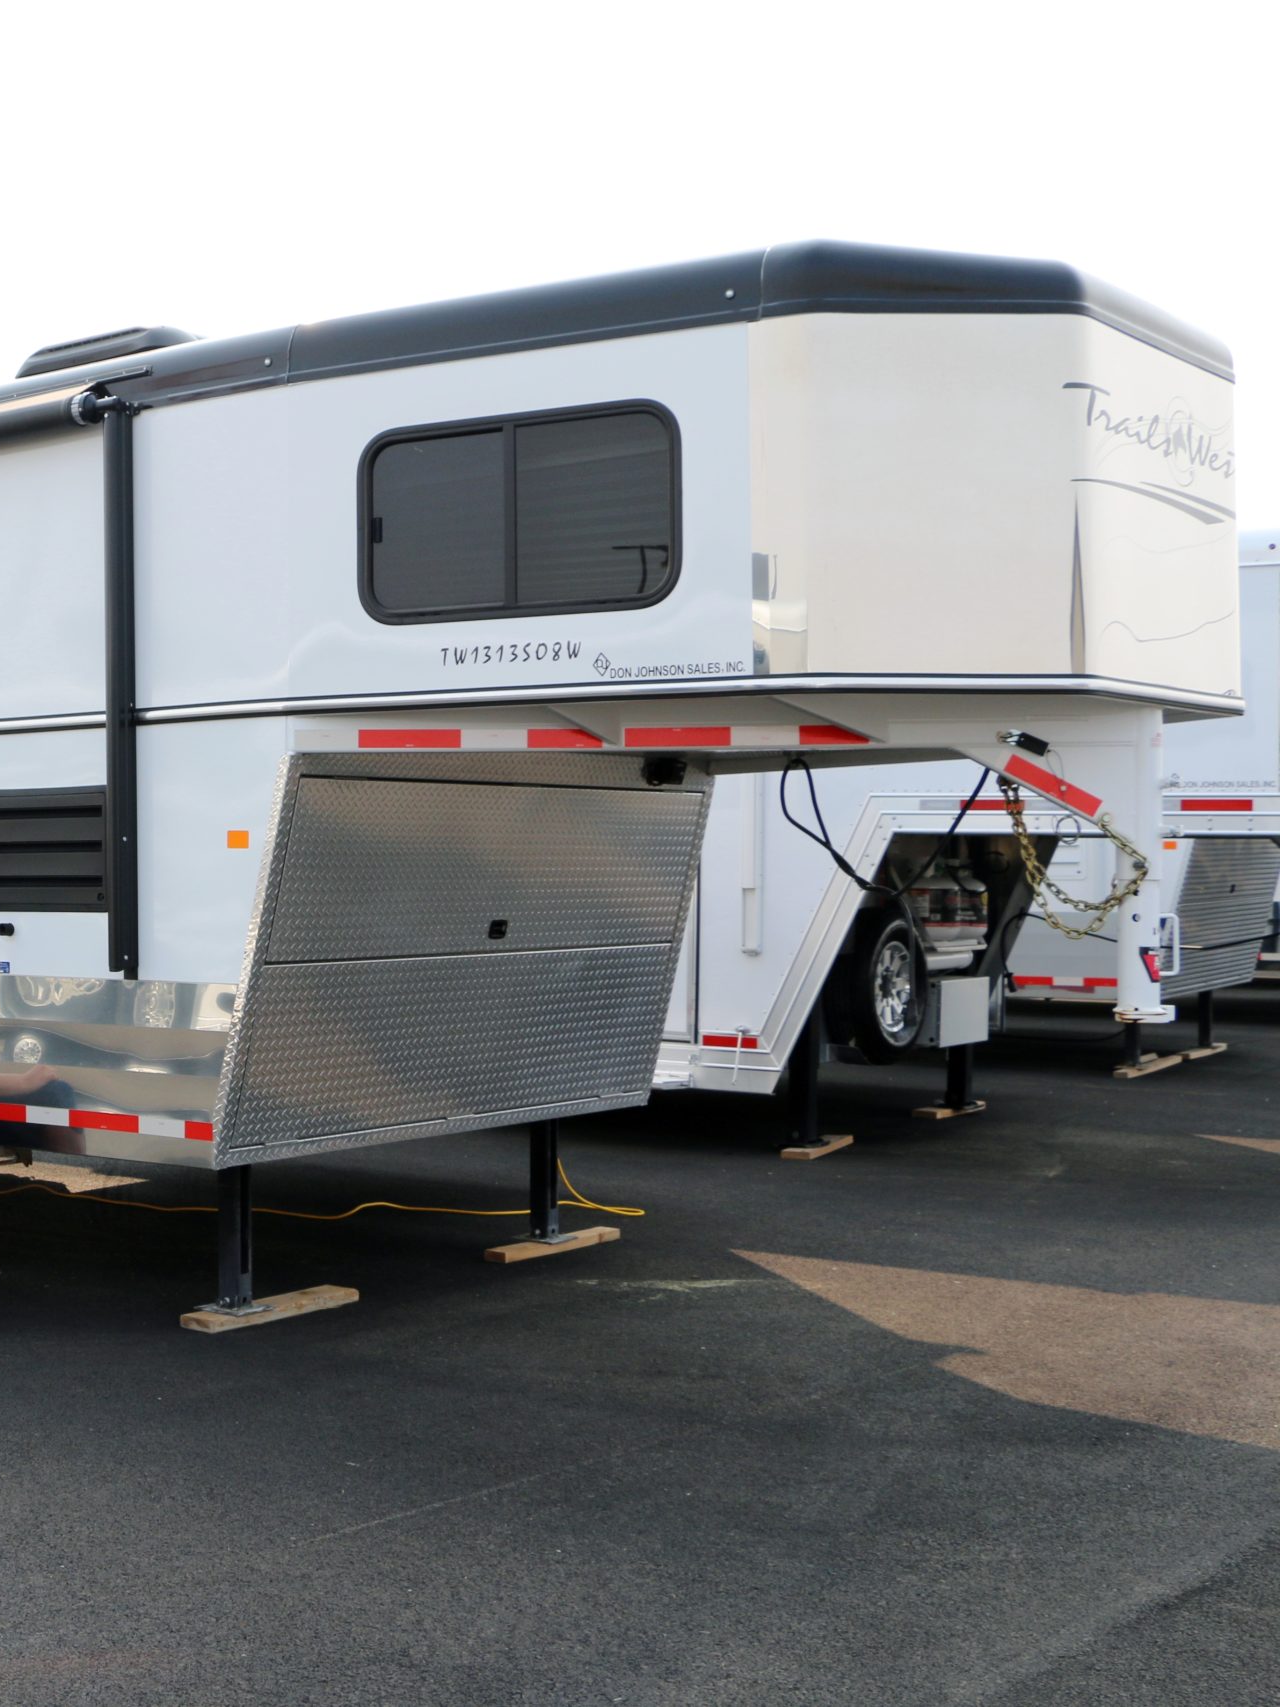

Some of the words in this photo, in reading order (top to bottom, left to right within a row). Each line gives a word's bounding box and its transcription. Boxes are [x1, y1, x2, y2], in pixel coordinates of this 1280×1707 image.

[1062, 382, 1175, 458] Trails
[1187, 419, 1235, 479] Wes
[610, 667, 632, 679] DON
[635, 664, 685, 678] JOHNSON
